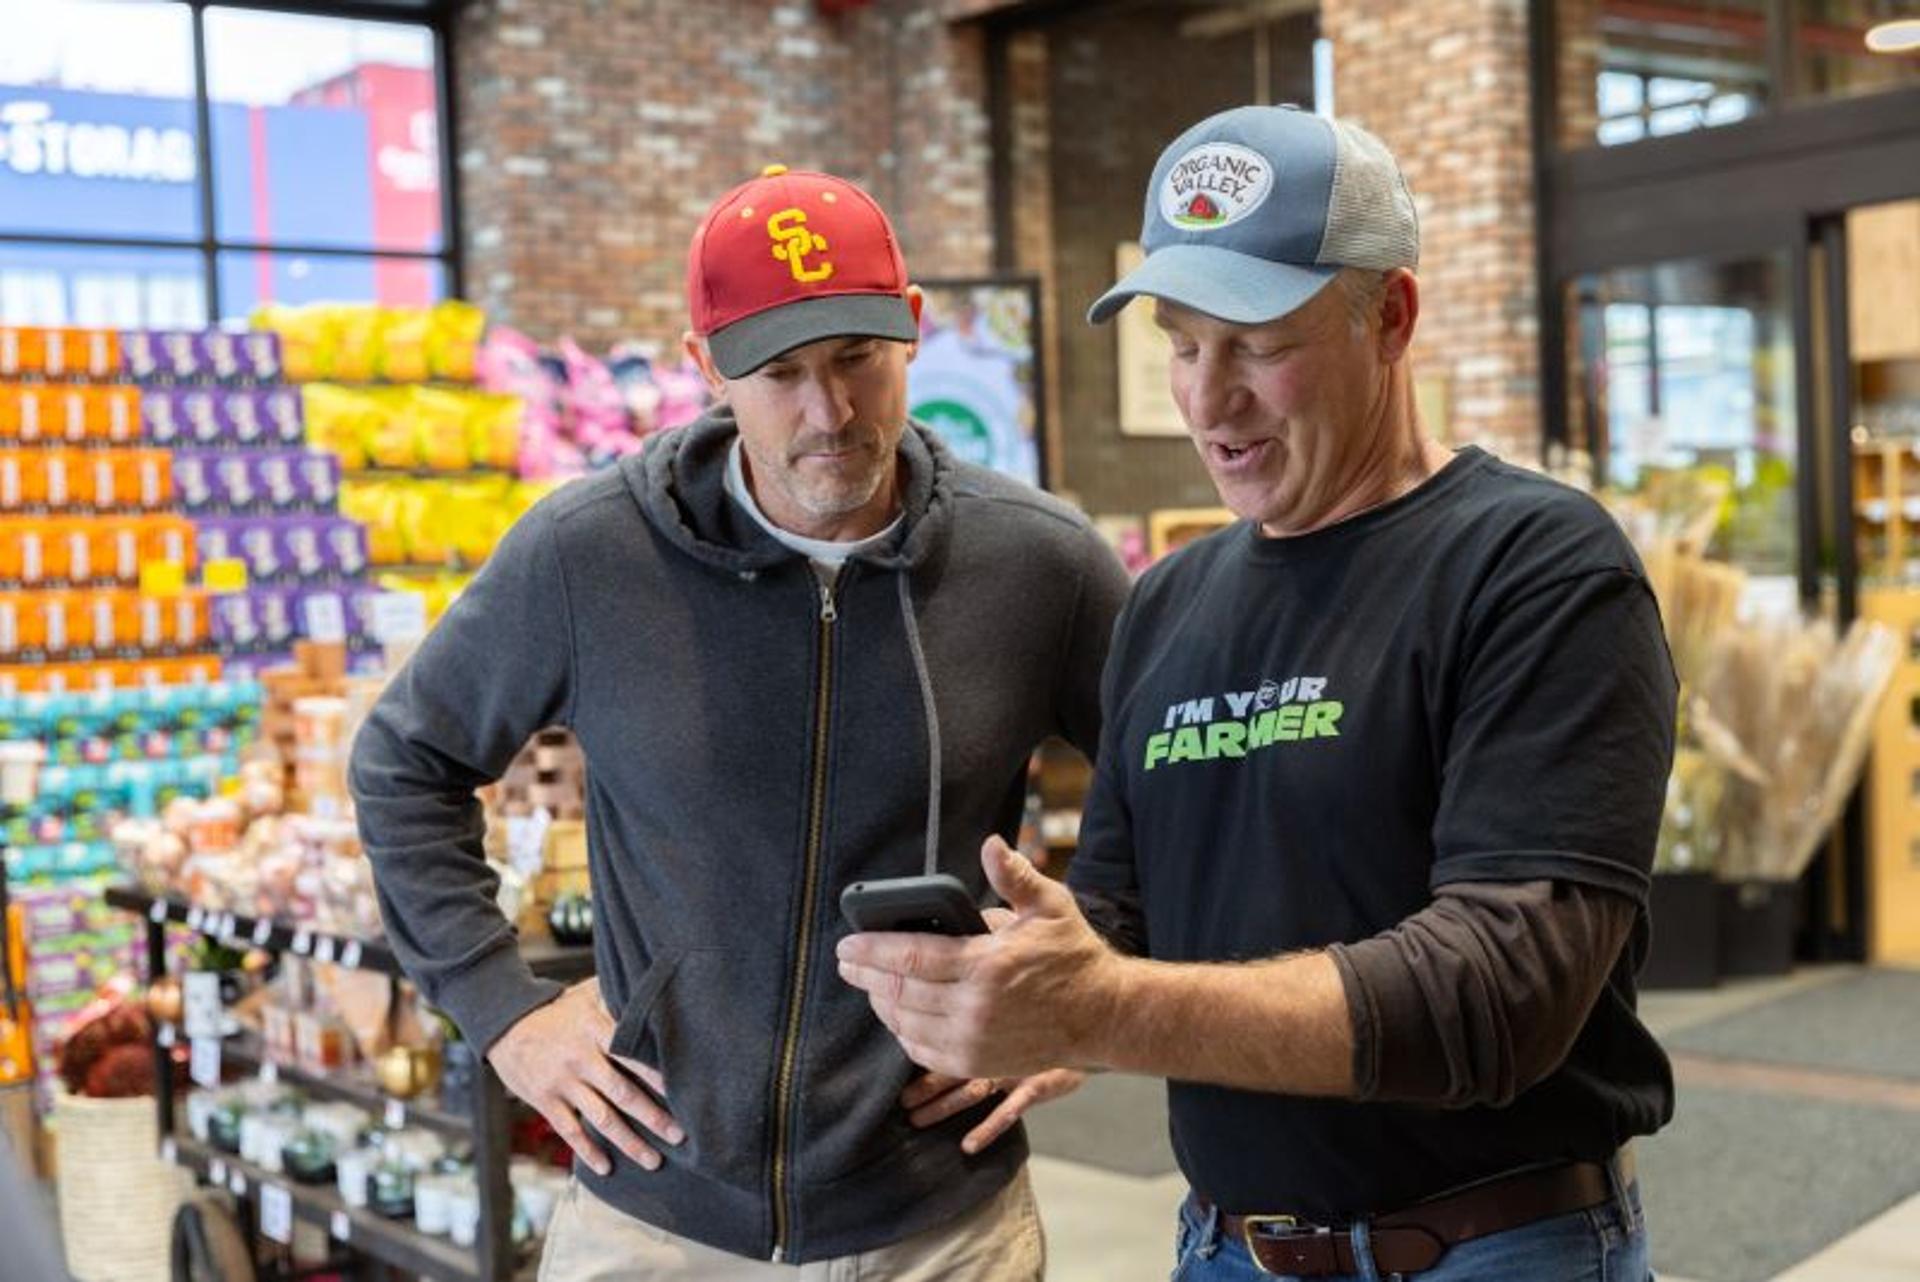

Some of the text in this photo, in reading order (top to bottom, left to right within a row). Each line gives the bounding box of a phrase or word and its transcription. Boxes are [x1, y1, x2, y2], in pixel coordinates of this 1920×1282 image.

[1170, 155, 1261, 184] ORGANIC
[1172, 173, 1247, 199] VALLEY
[767, 208, 833, 282] SC
[1164, 697, 1213, 729] I'M
[1144, 701, 1344, 769] FARMER
